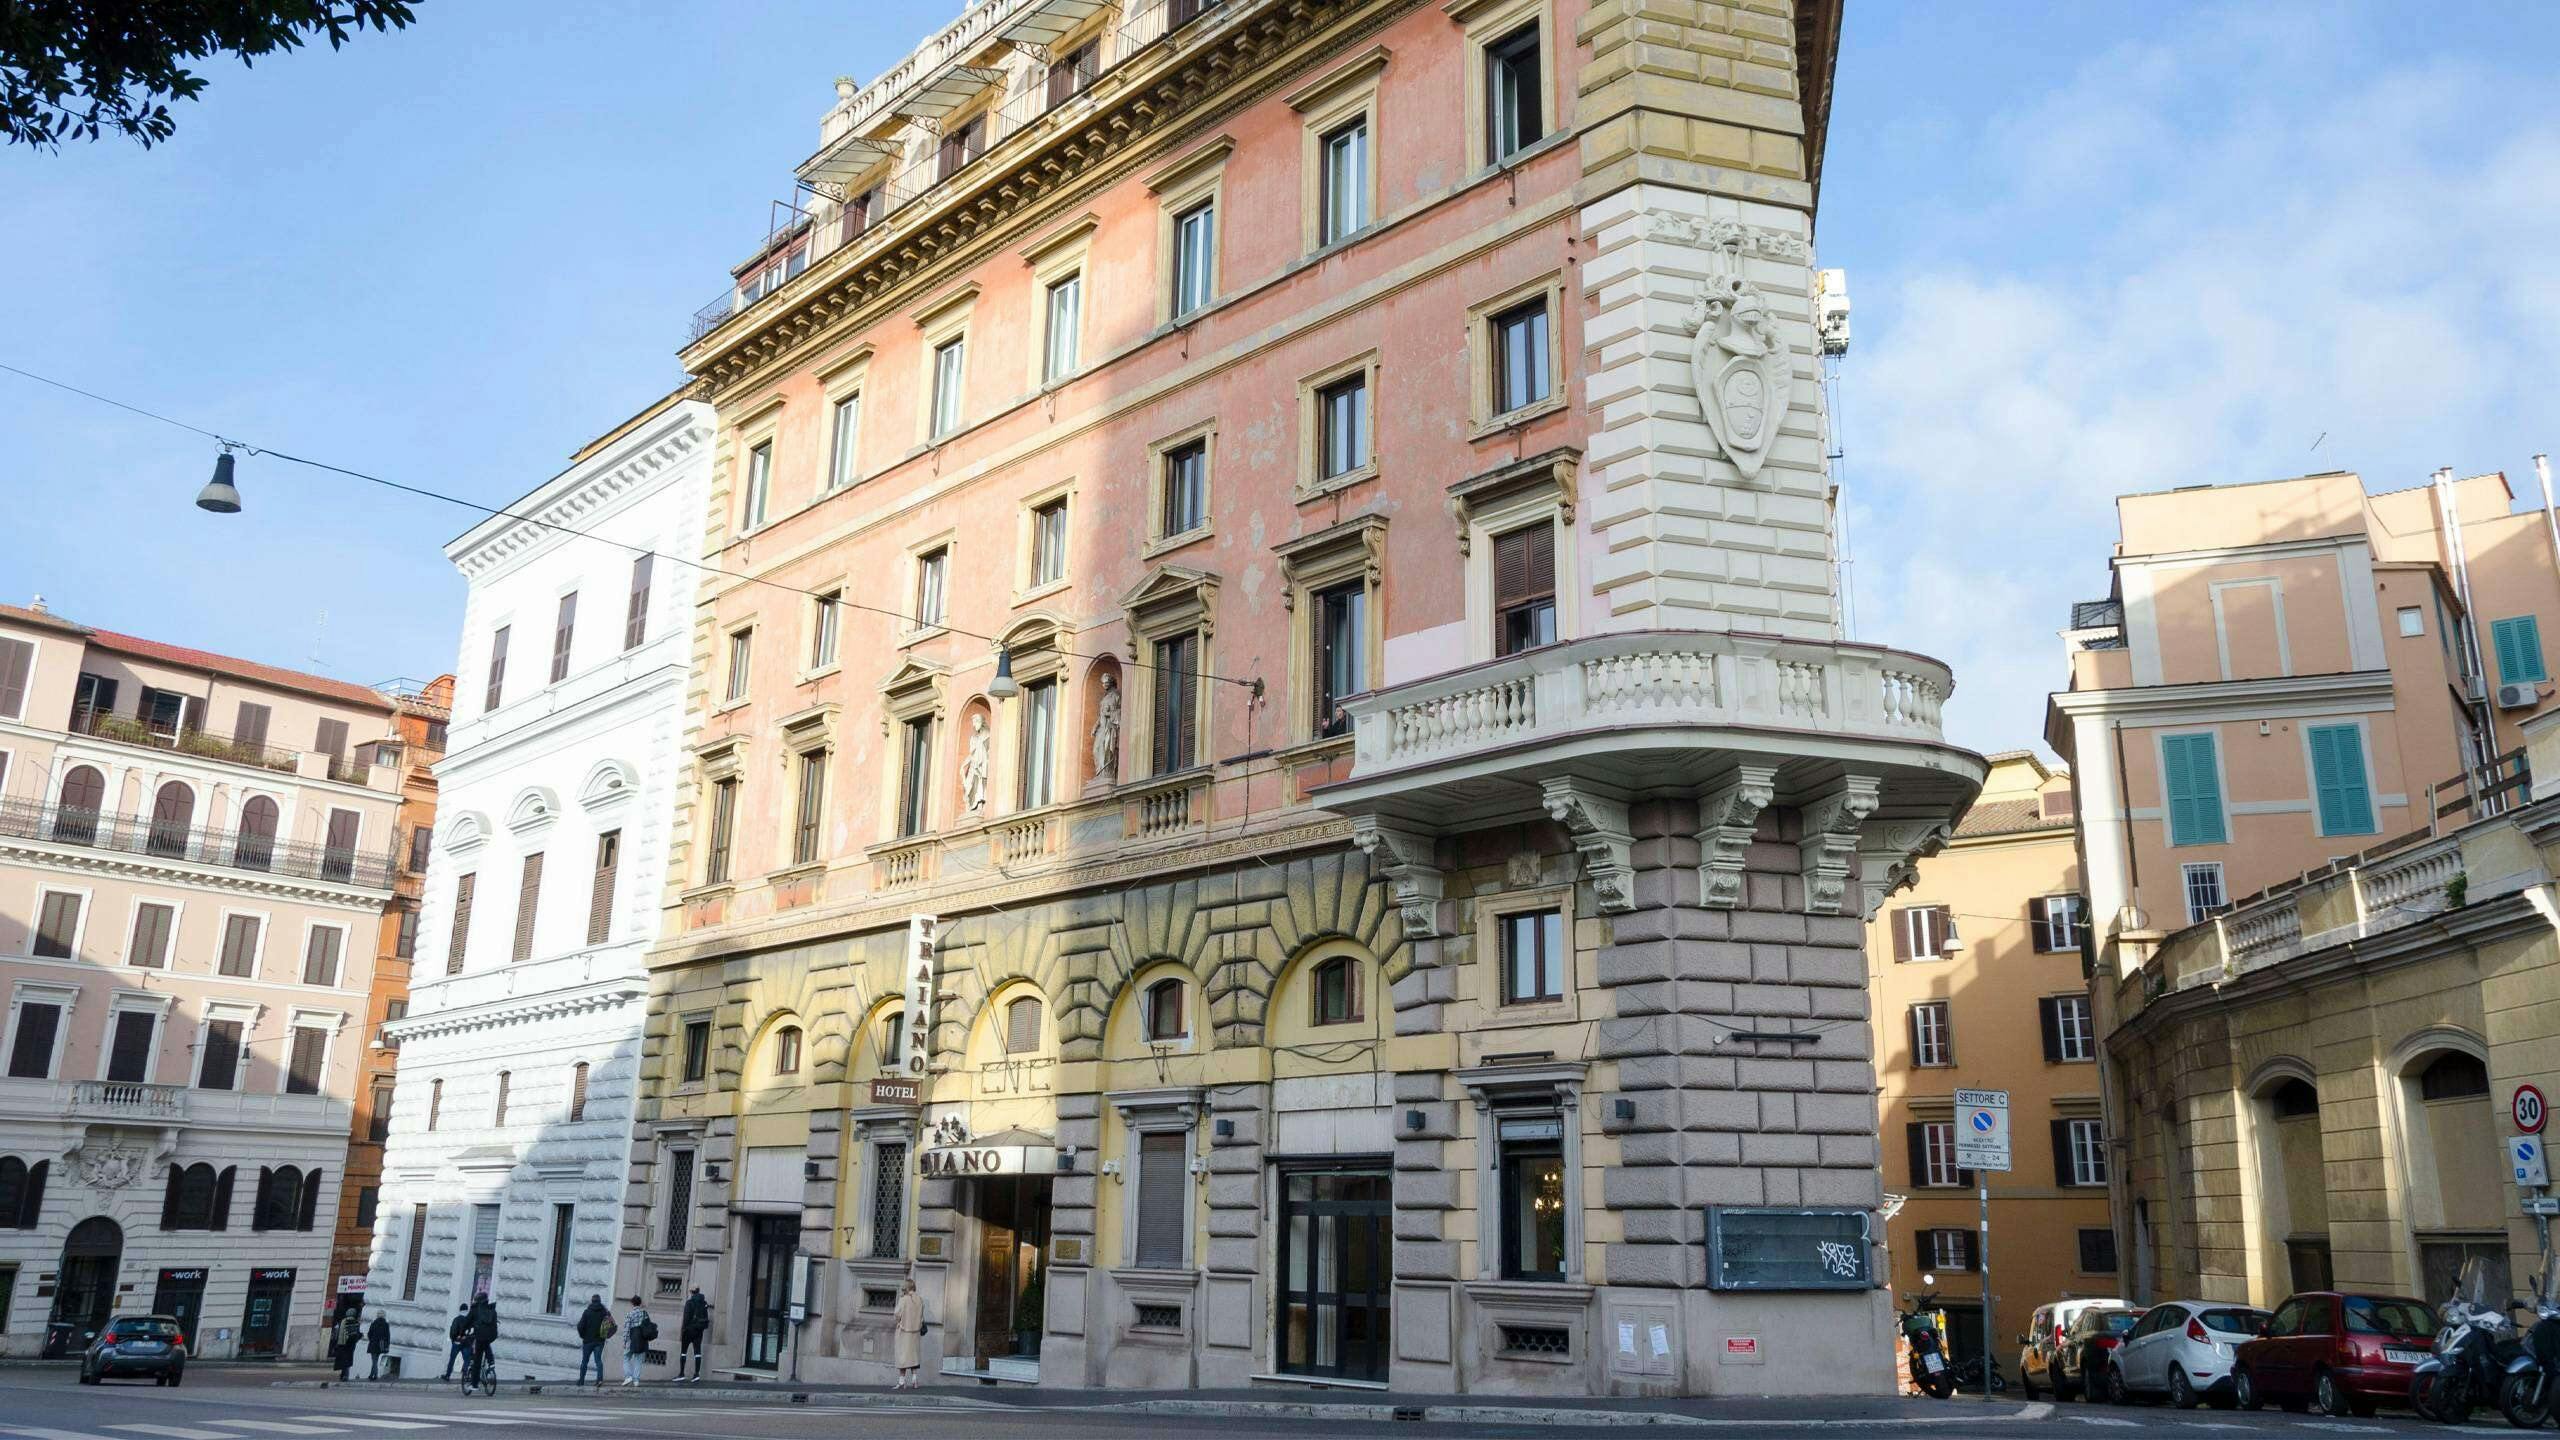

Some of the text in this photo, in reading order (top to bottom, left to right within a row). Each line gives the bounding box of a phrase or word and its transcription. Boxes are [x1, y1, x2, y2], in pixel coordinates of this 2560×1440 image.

[909, 918, 935, 1073] TRAIANO
[875, 1084, 917, 1099] HOTEL
[1958, 1092, 2005, 1105] SETTORE C
[2519, 1097, 2538, 1120] 30
